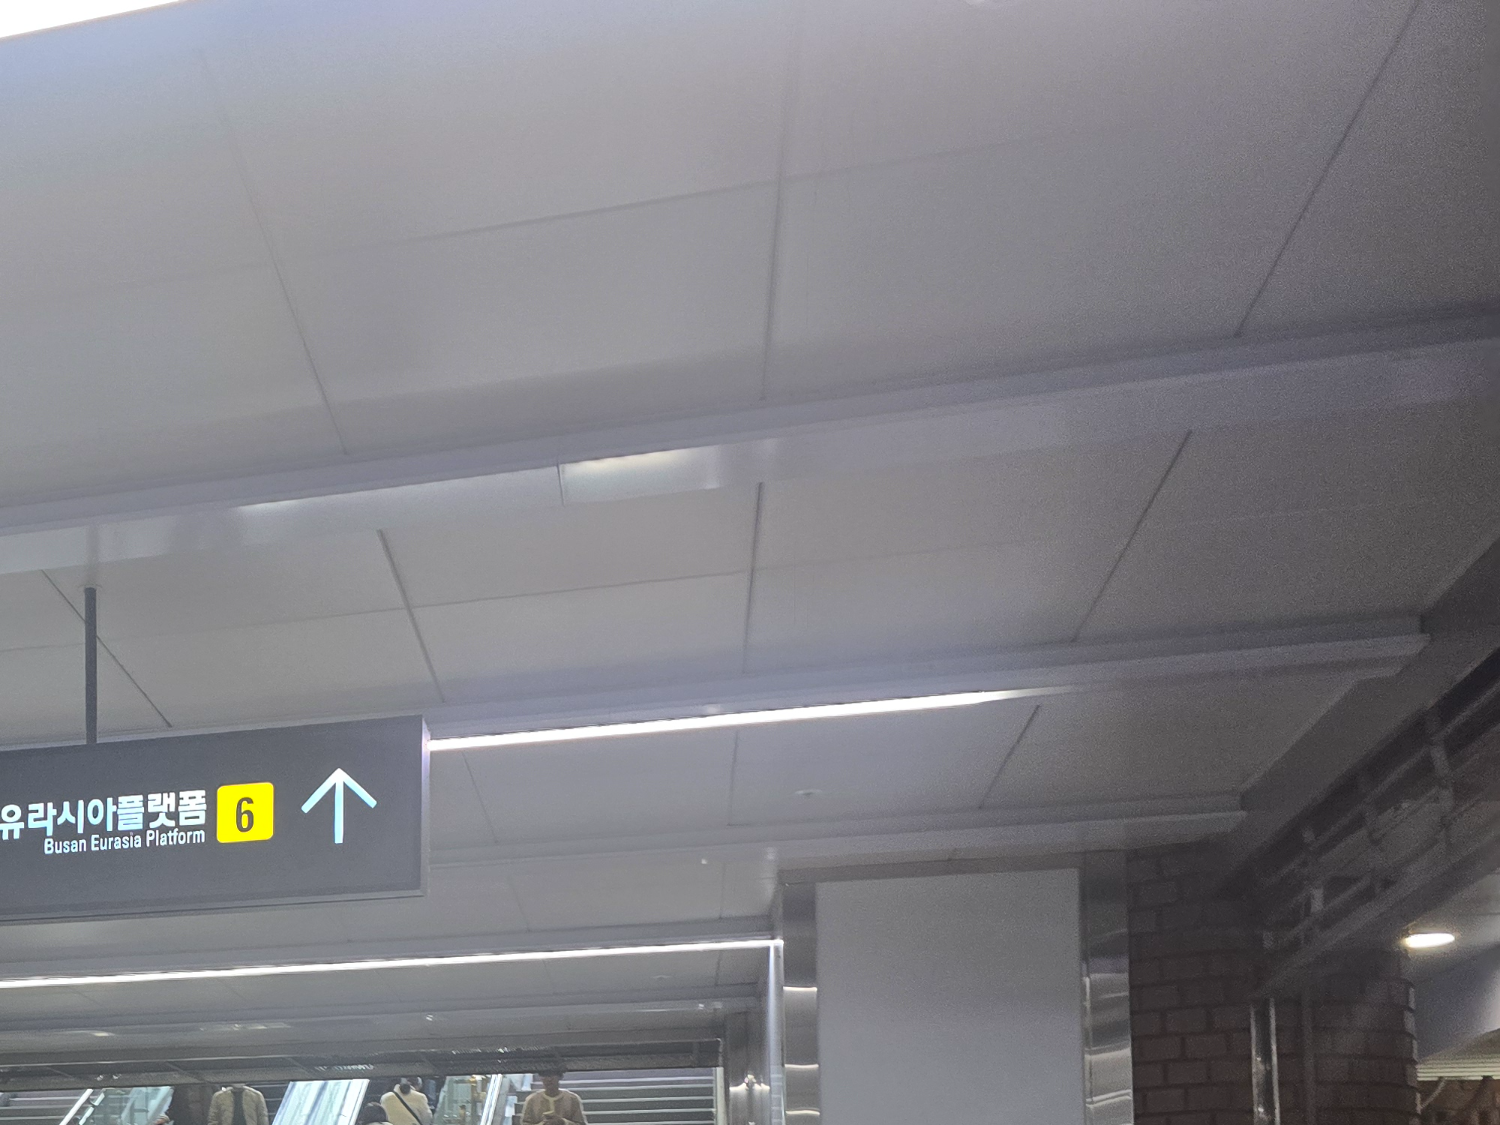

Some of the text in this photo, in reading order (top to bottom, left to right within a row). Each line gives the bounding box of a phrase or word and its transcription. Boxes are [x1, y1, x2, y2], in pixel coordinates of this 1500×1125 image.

[234, 796, 255, 833] 6
[43, 828, 206, 855] Busan Eurasia Platform
